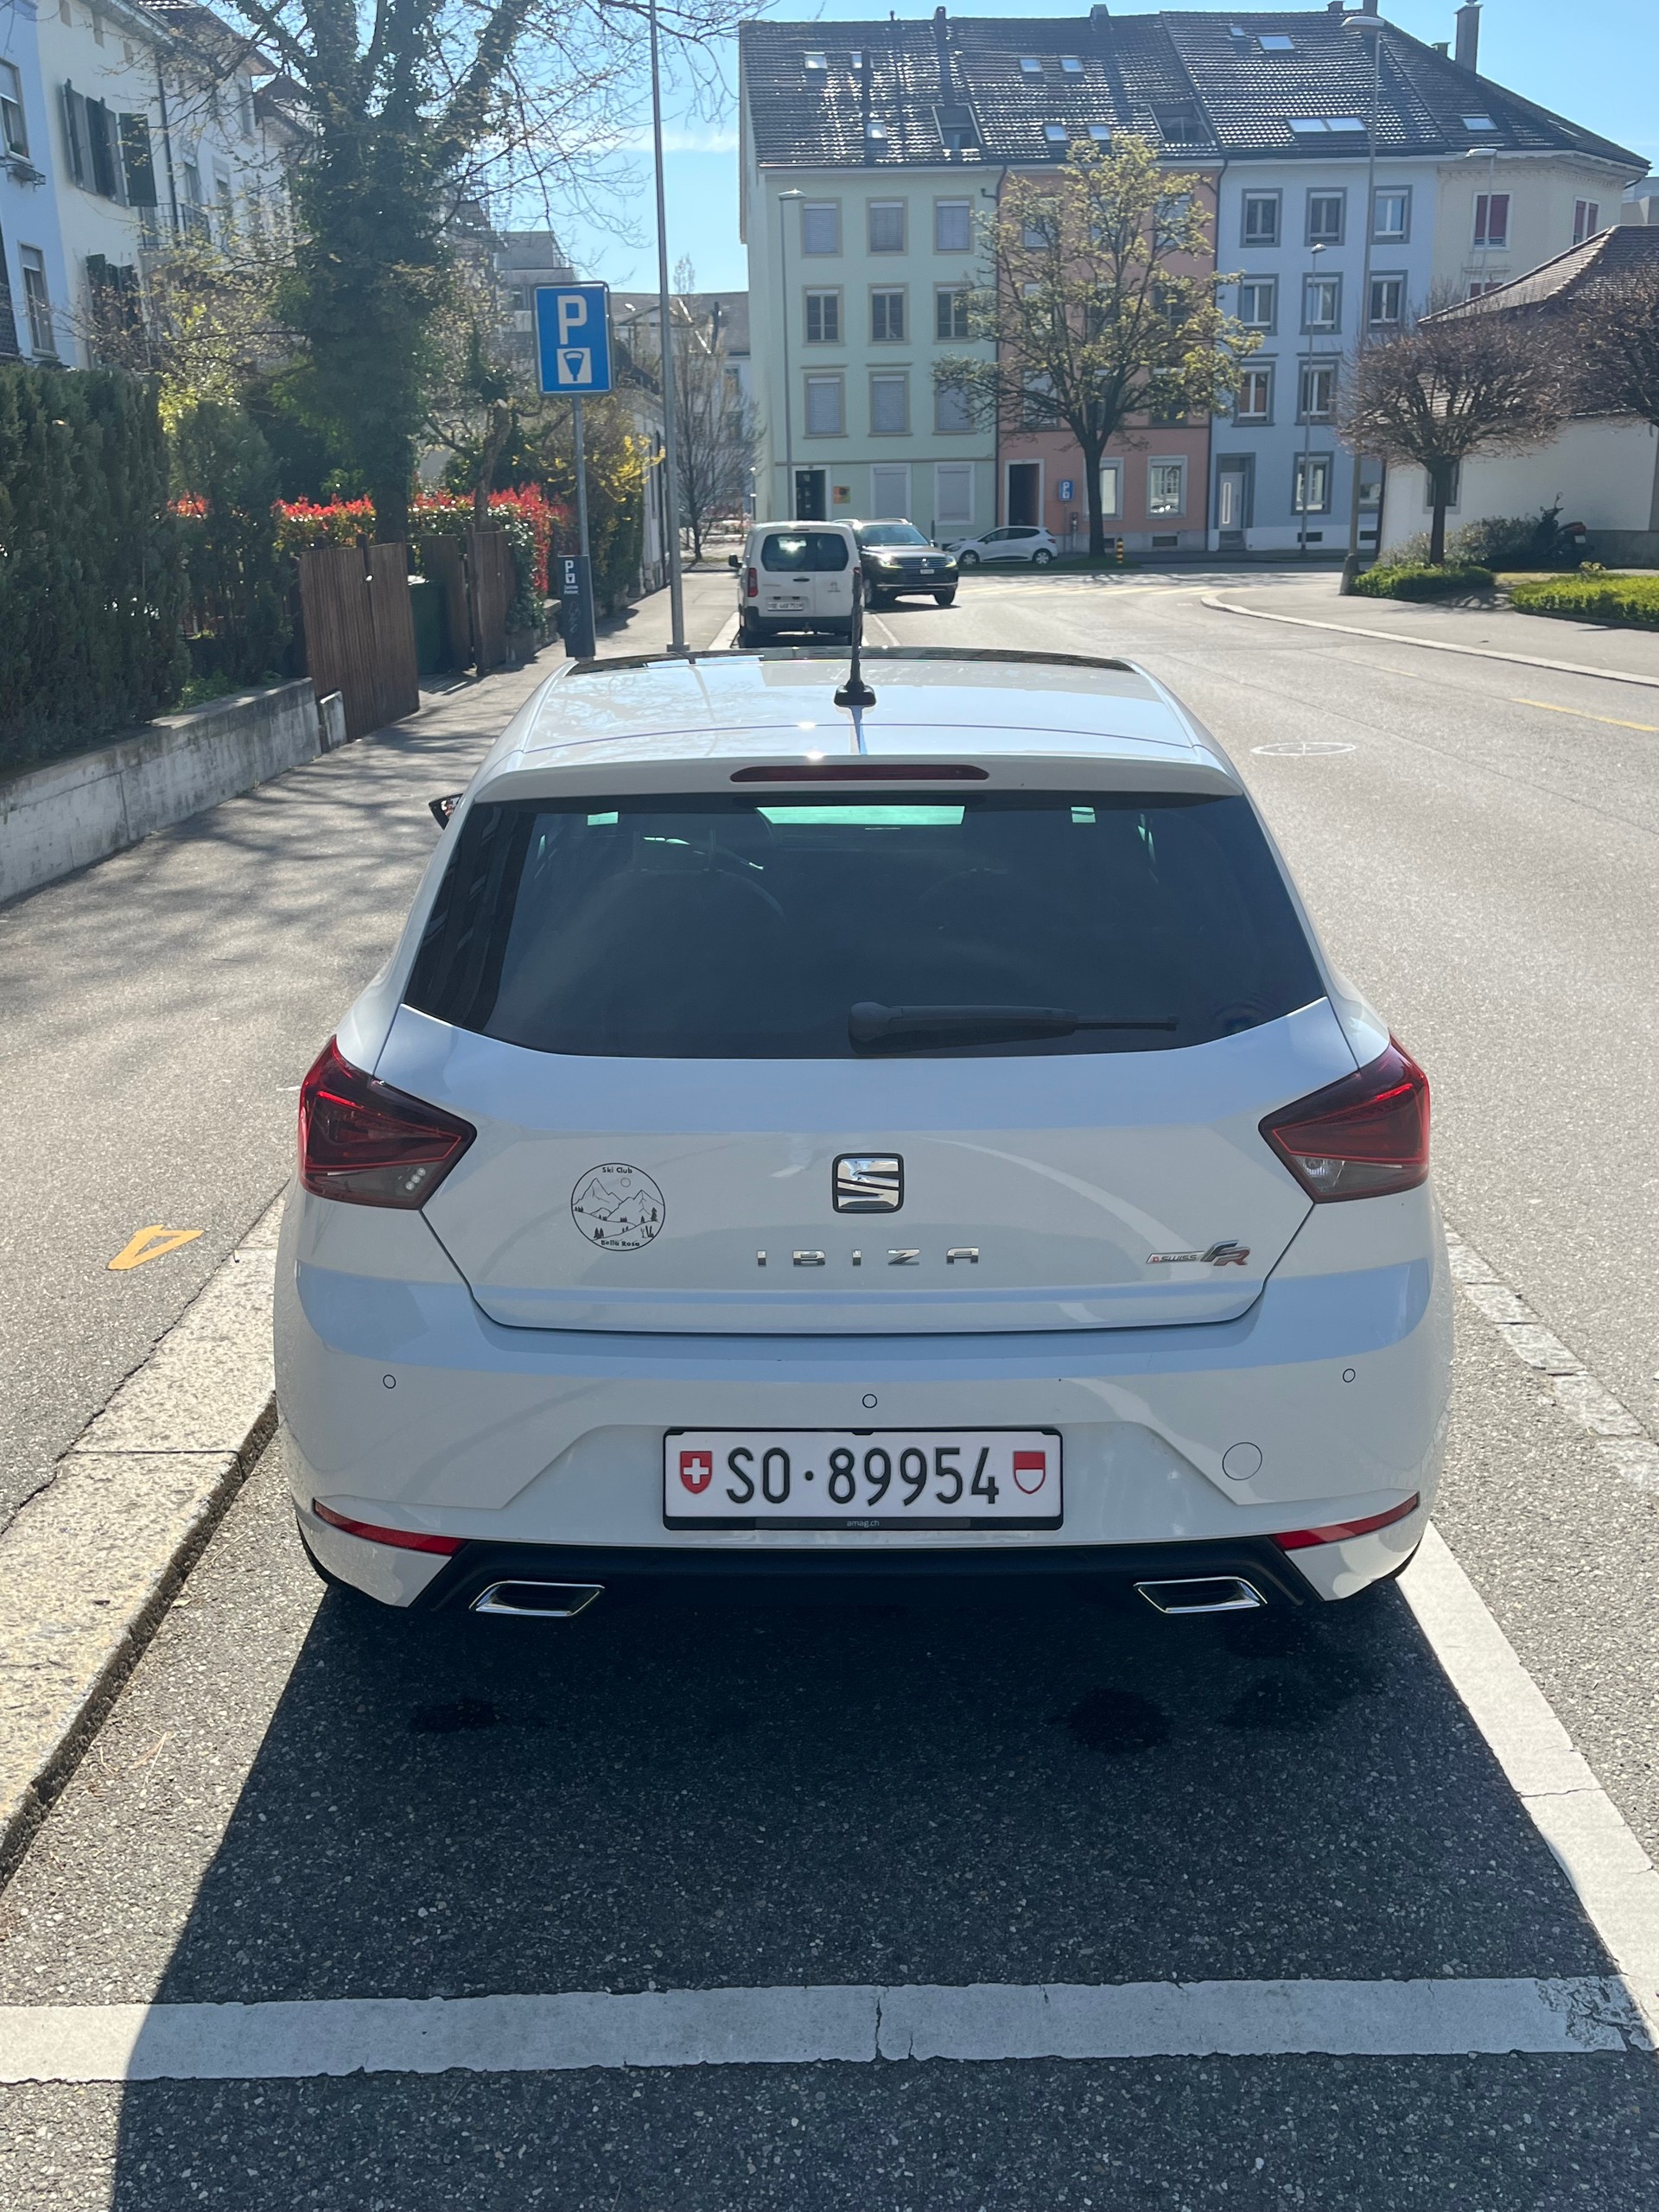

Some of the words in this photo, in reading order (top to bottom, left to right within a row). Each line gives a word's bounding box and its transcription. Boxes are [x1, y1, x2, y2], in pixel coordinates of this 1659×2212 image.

[557, 295, 588, 345] P
[564, 560, 575, 574] P
[757, 1247, 979, 1266] IBIZA
[1161, 1254, 1198, 1262] SWISS
[847, 1519, 880, 1529] amag.ch
